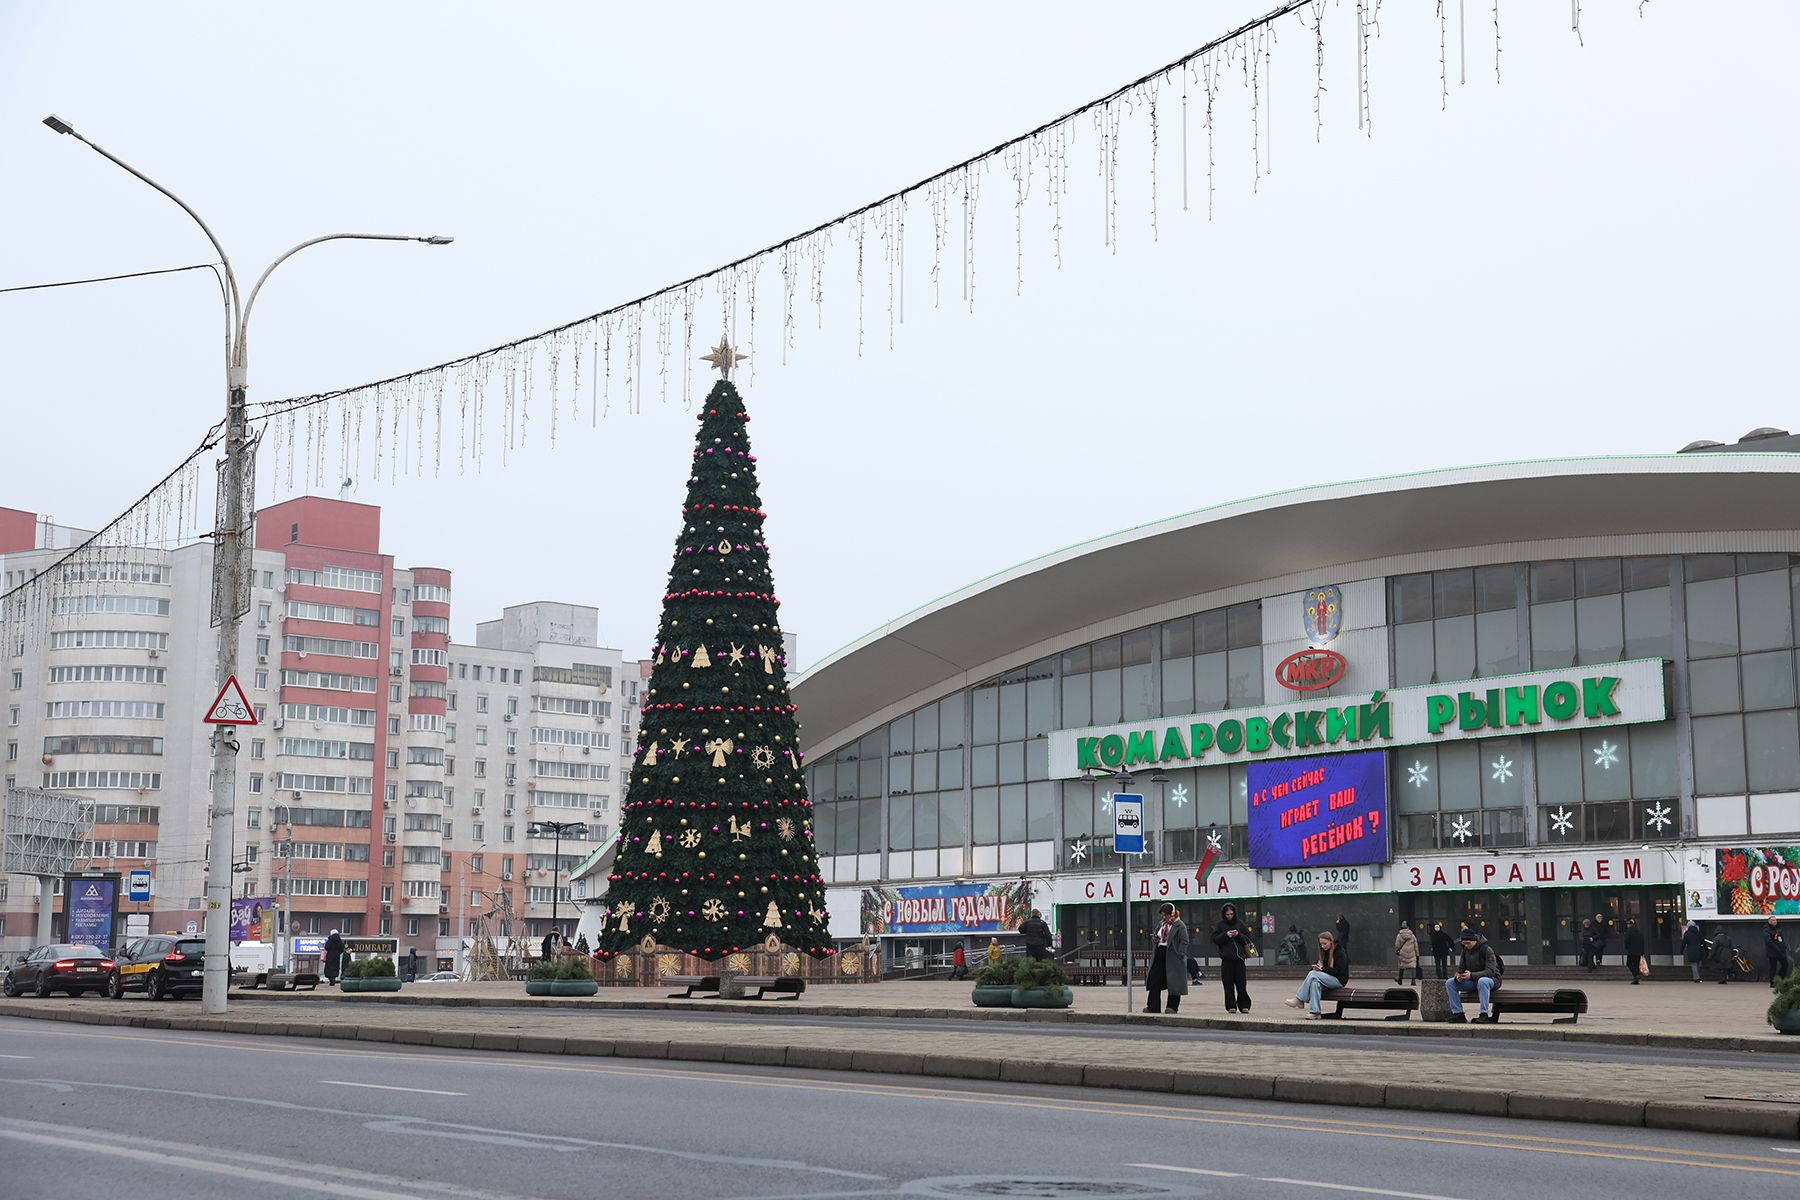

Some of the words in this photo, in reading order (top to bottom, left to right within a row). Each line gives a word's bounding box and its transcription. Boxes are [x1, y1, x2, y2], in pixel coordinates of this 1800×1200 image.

[1287, 657, 1335, 683] МКР
[1077, 691, 1393, 769] КОМАРОВСКИЙ
[1427, 676, 1621, 734] РЫНОК
[1253, 793, 1259, 806] А
[1262, 789, 1267, 802] С
[1291, 767, 1326, 792] СЕЙЧАС
[1281, 799, 1320, 829] ИГРАЕТ
[1329, 787, 1355, 810] ВАШ
[1302, 815, 1364, 860] РЕБЁНОК
[1085, 876, 1229, 898] САДЭЧНА
[1410, 858, 1641, 886] ЗАПРАШАЕМ
[1286, 871, 1311, 884] 9.00
[1324, 869, 1358, 883] 19.00
[1286, 884, 1315, 892] ВЫХОДНОЙ
[1319, 884, 1359, 892] ПОНЕДЕЛЬНИК
[1750, 865, 1764, 898] С
[884, 900, 892, 923] С
[896, 898, 946, 924] НОВЫМ
[950, 895, 1007, 928] ГОДОМ!
[353, 943, 392, 952] ЛОМБАРД
